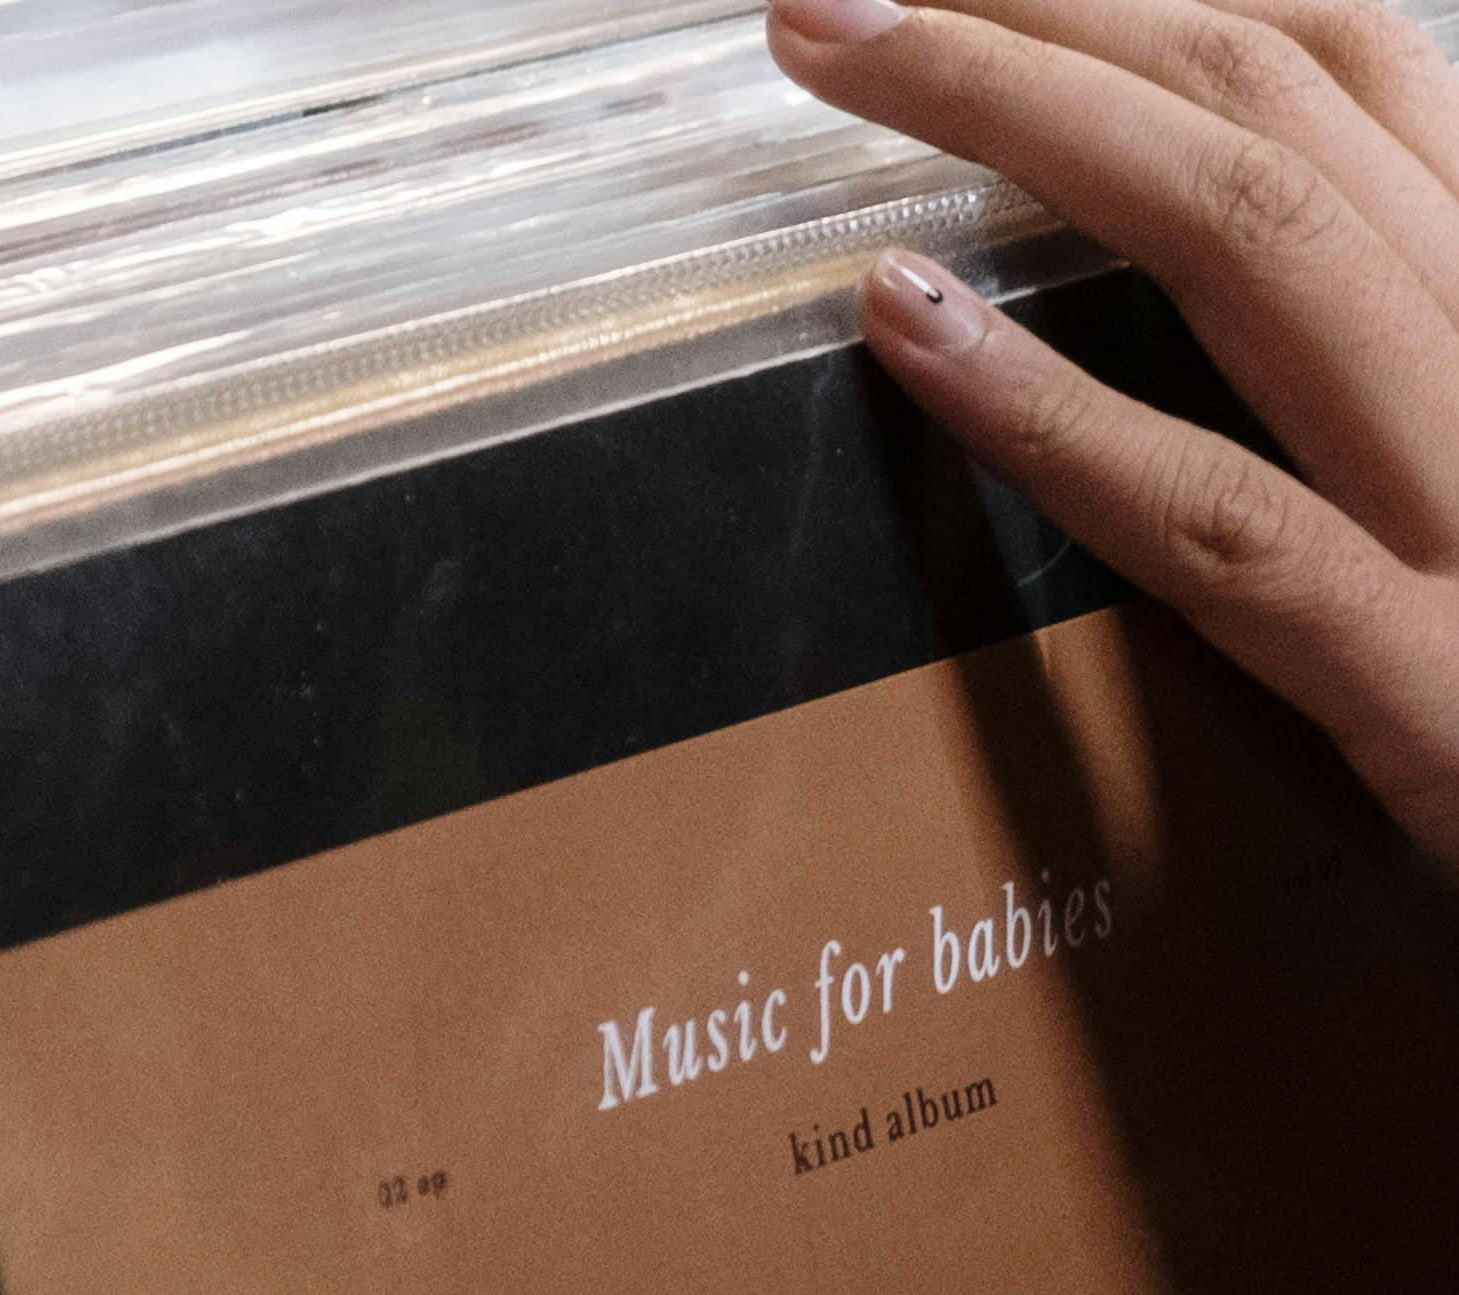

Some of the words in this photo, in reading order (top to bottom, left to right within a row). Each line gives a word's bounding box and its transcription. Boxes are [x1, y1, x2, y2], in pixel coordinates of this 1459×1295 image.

[597, 970, 789, 1111] Music
[808, 941, 907, 1065] for
[929, 867, 1114, 995] babies
[789, 1106, 875, 1176] kind
[887, 1075, 999, 1145] album
